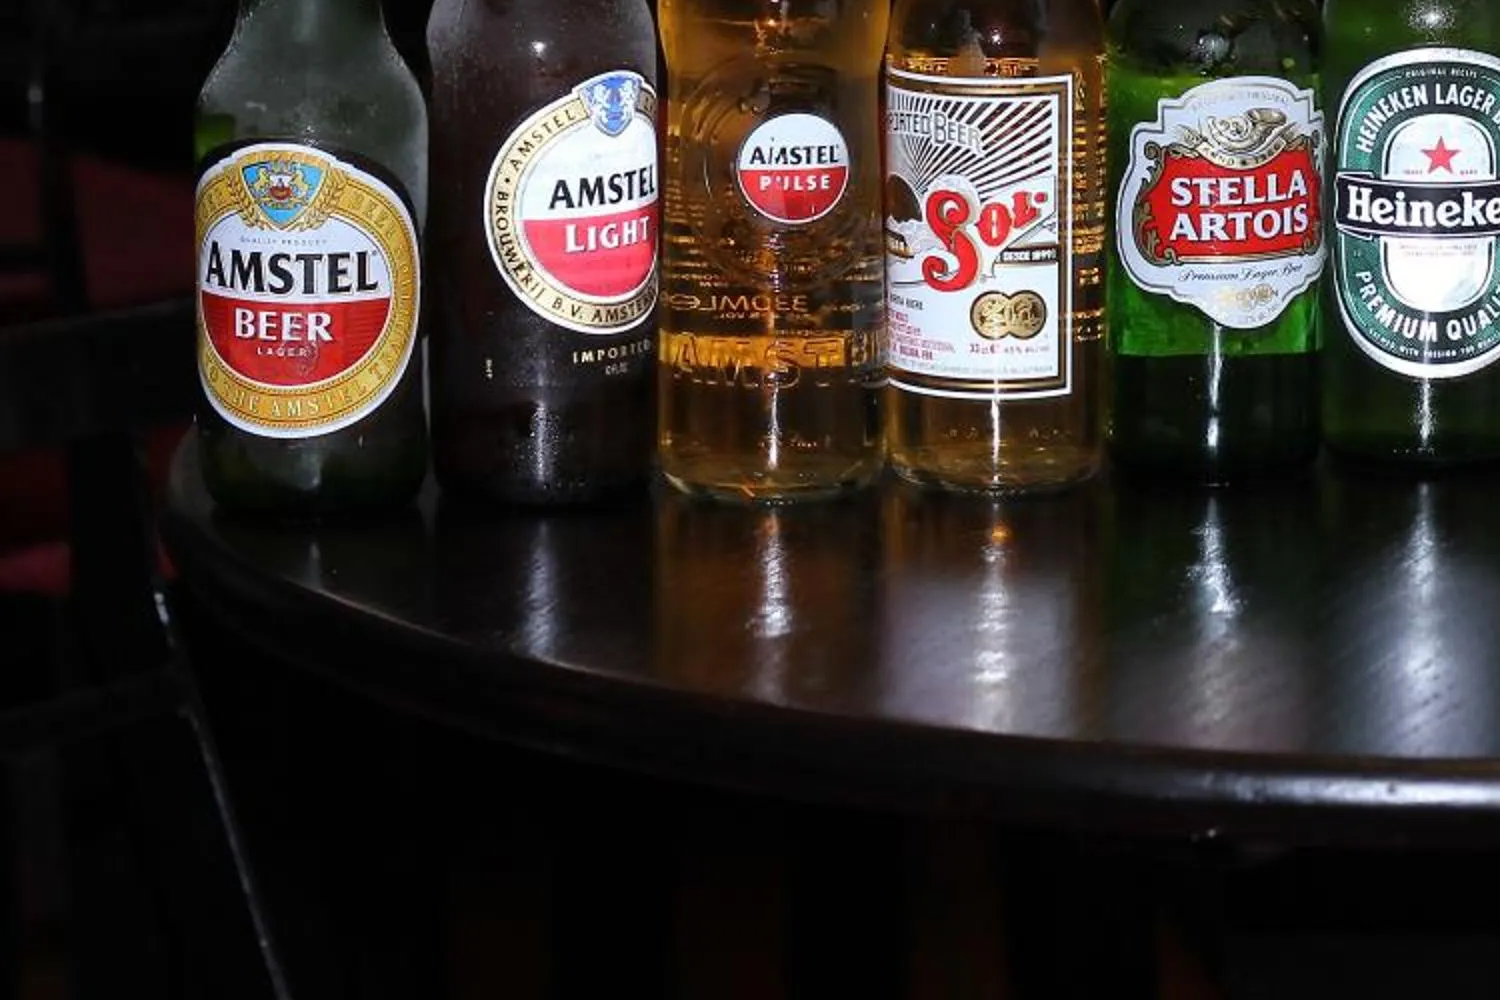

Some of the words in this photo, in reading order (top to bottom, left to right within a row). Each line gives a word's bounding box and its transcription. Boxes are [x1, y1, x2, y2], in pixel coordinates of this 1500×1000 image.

[932, 112, 982, 150] BEER
[1355, 84, 1428, 154] HEINEKEN
[1434, 83, 1497, 117] LAGER
[509, 107, 577, 173] AMSTEL
[748, 143, 840, 166] AMSTEL
[548, 163, 655, 211] AMSTEL
[759, 173, 831, 193] PULSE
[1171, 169, 1308, 207] STELLA
[564, 215, 651, 253] LIGHT
[1170, 203, 1309, 241] ARTOIS
[496, 190, 546, 300] BROUWERIJ
[205, 240, 379, 296] AMSTEL
[235, 307, 333, 342] BEER
[1355, 270, 1439, 343] PREMIUM
[257, 346, 309, 357] LAGER
